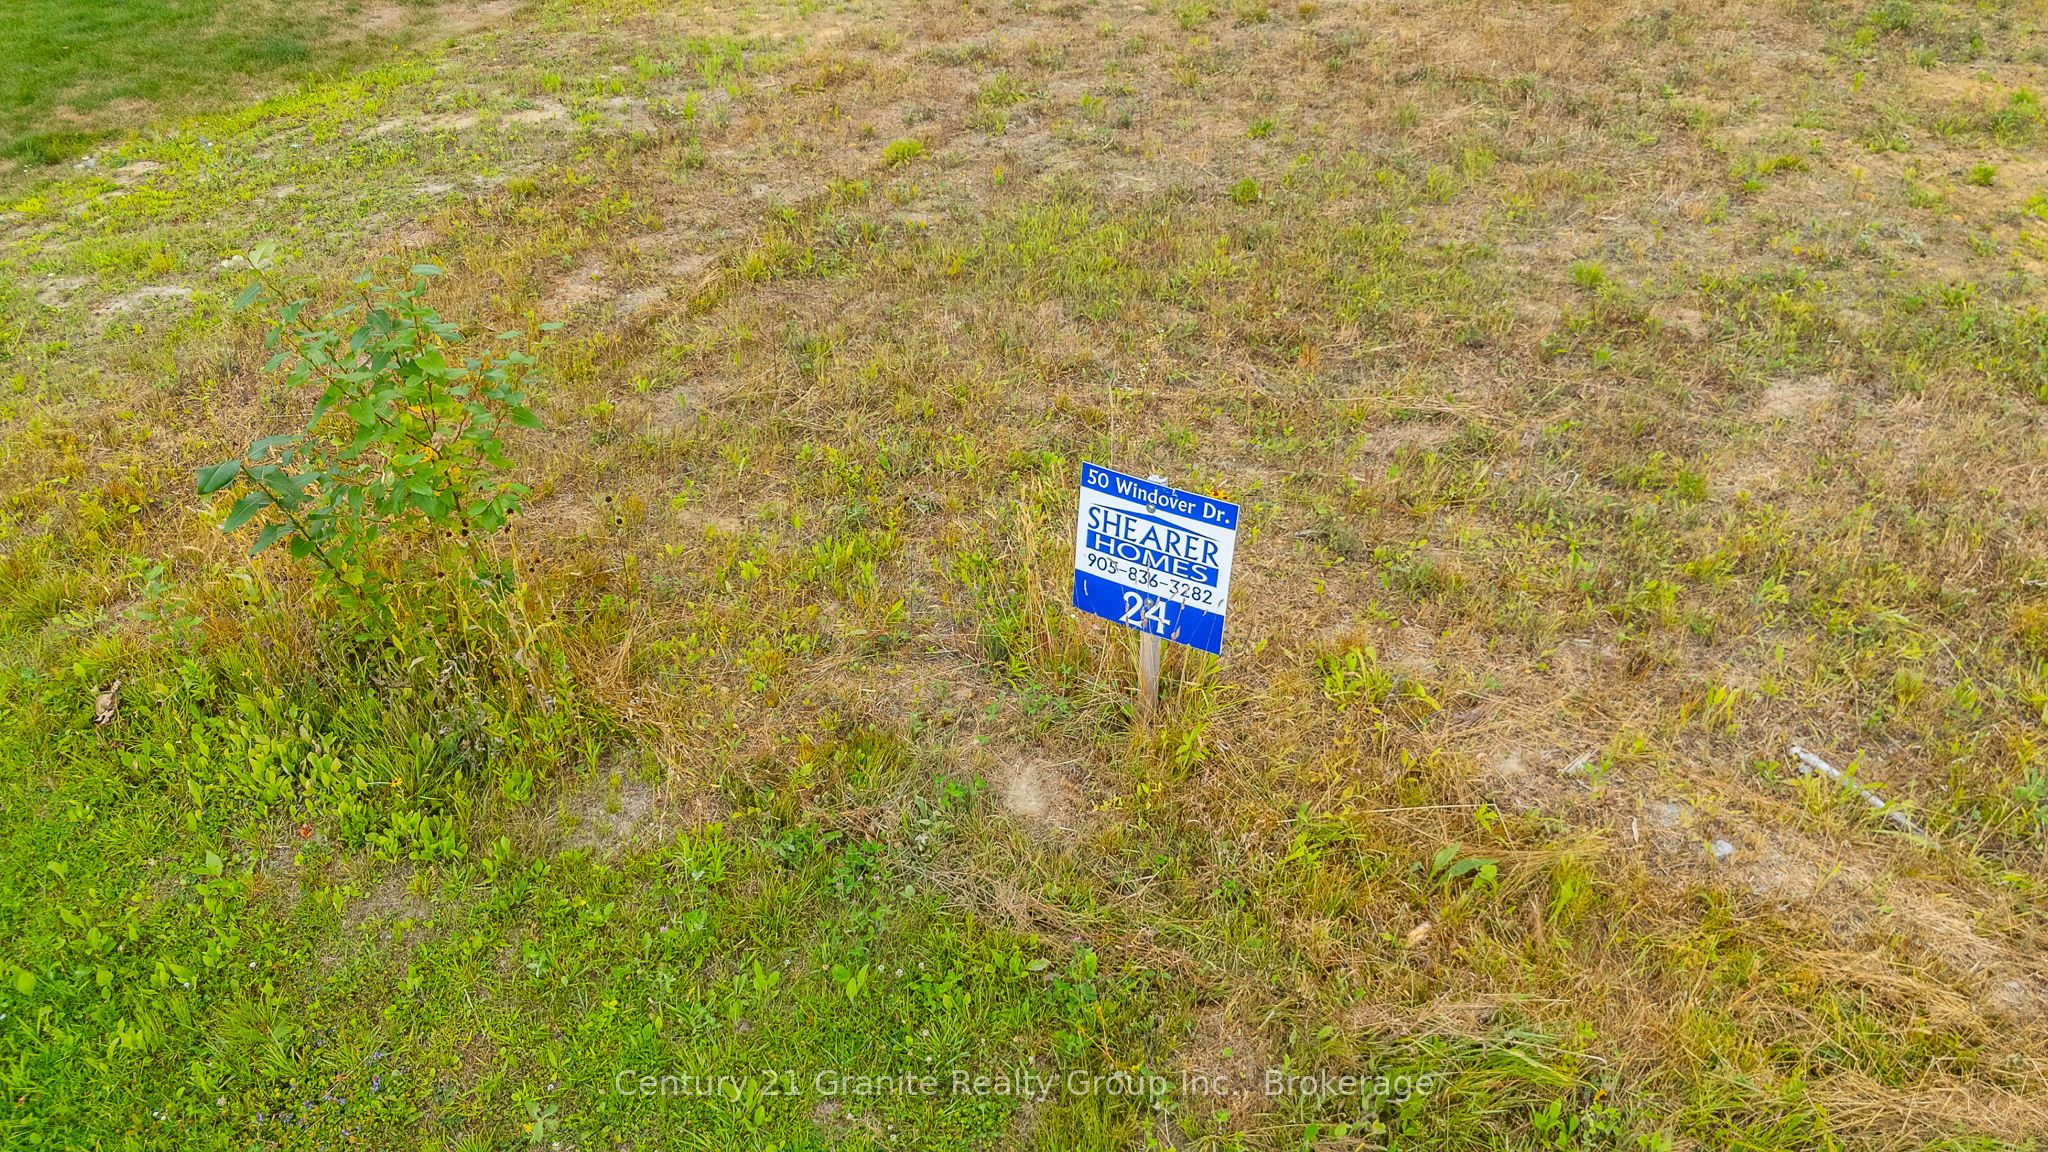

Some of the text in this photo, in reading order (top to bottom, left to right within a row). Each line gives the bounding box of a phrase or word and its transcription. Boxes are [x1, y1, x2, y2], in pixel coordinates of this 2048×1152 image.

[1087, 468, 1230, 525] 50 Windover Dr.
[1087, 506, 1219, 567] SHEARER
[1094, 533, 1208, 583] HOMES
[1087, 553, 1212, 605] 905-836-3282
[1119, 590, 1171, 635] 24
